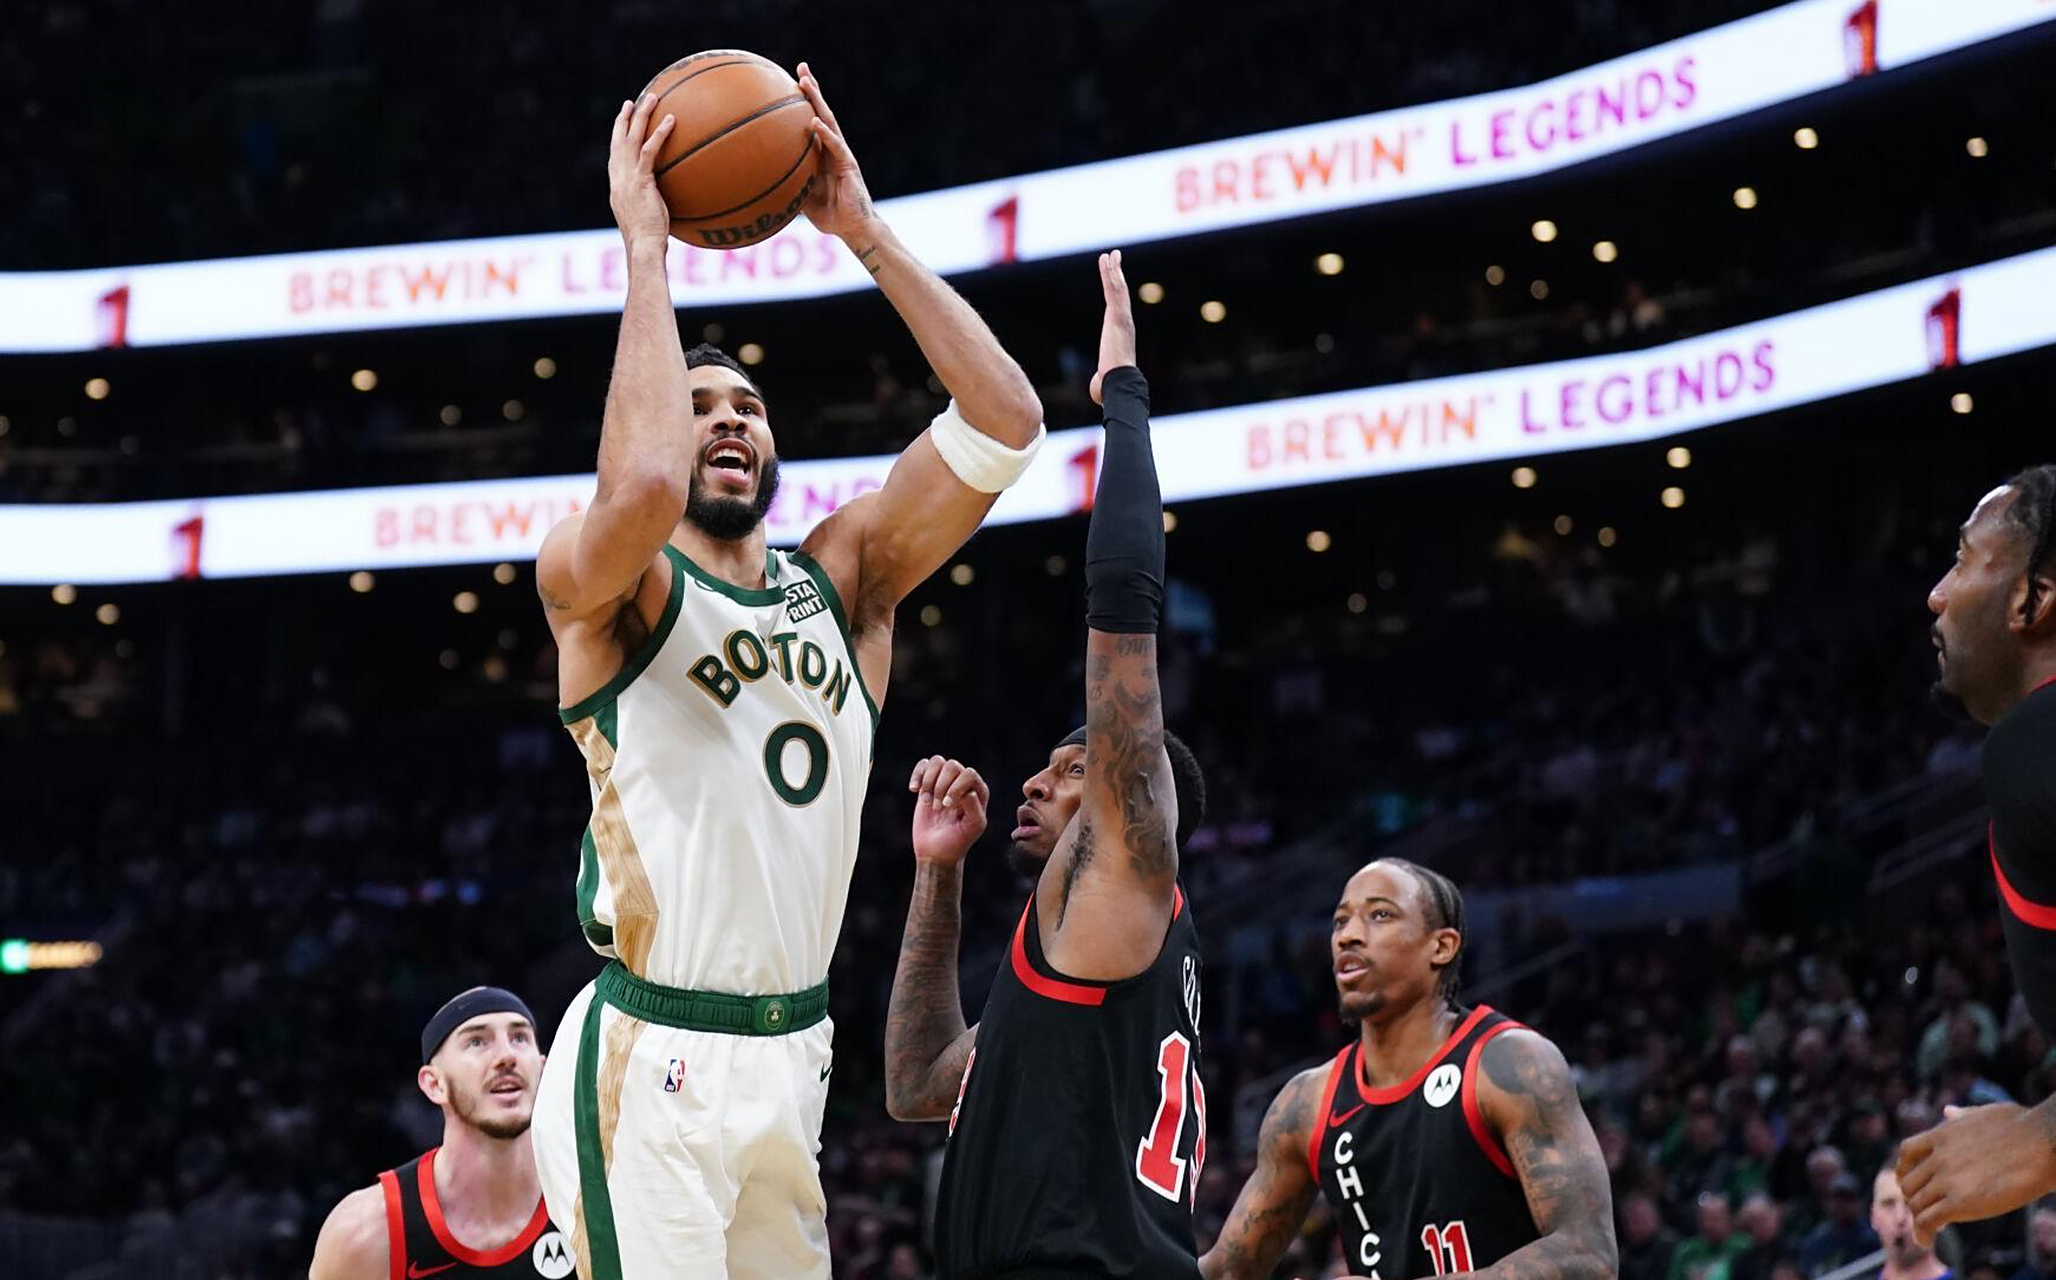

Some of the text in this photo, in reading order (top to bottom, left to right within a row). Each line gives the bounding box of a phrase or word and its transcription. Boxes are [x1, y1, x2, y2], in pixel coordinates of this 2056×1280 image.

[1846, 0, 1878, 76] 1
[1451, 56, 1696, 166] LEGENDS
[987, 195, 1018, 263] 1
[562, 236, 836, 292] LEENDS
[99, 285, 130, 348] 1
[1926, 288, 1960, 369] 1
[1522, 342, 1774, 434] LEGENDS
[1069, 445, 1098, 513] 1
[171, 515, 204, 579] 1
[785, 582, 817, 604] STA
[786, 595, 824, 621] RINT
[686, 629, 851, 717] BOTON
[762, 719, 831, 808] 0
[1420, 1220, 1475, 1277] 11
